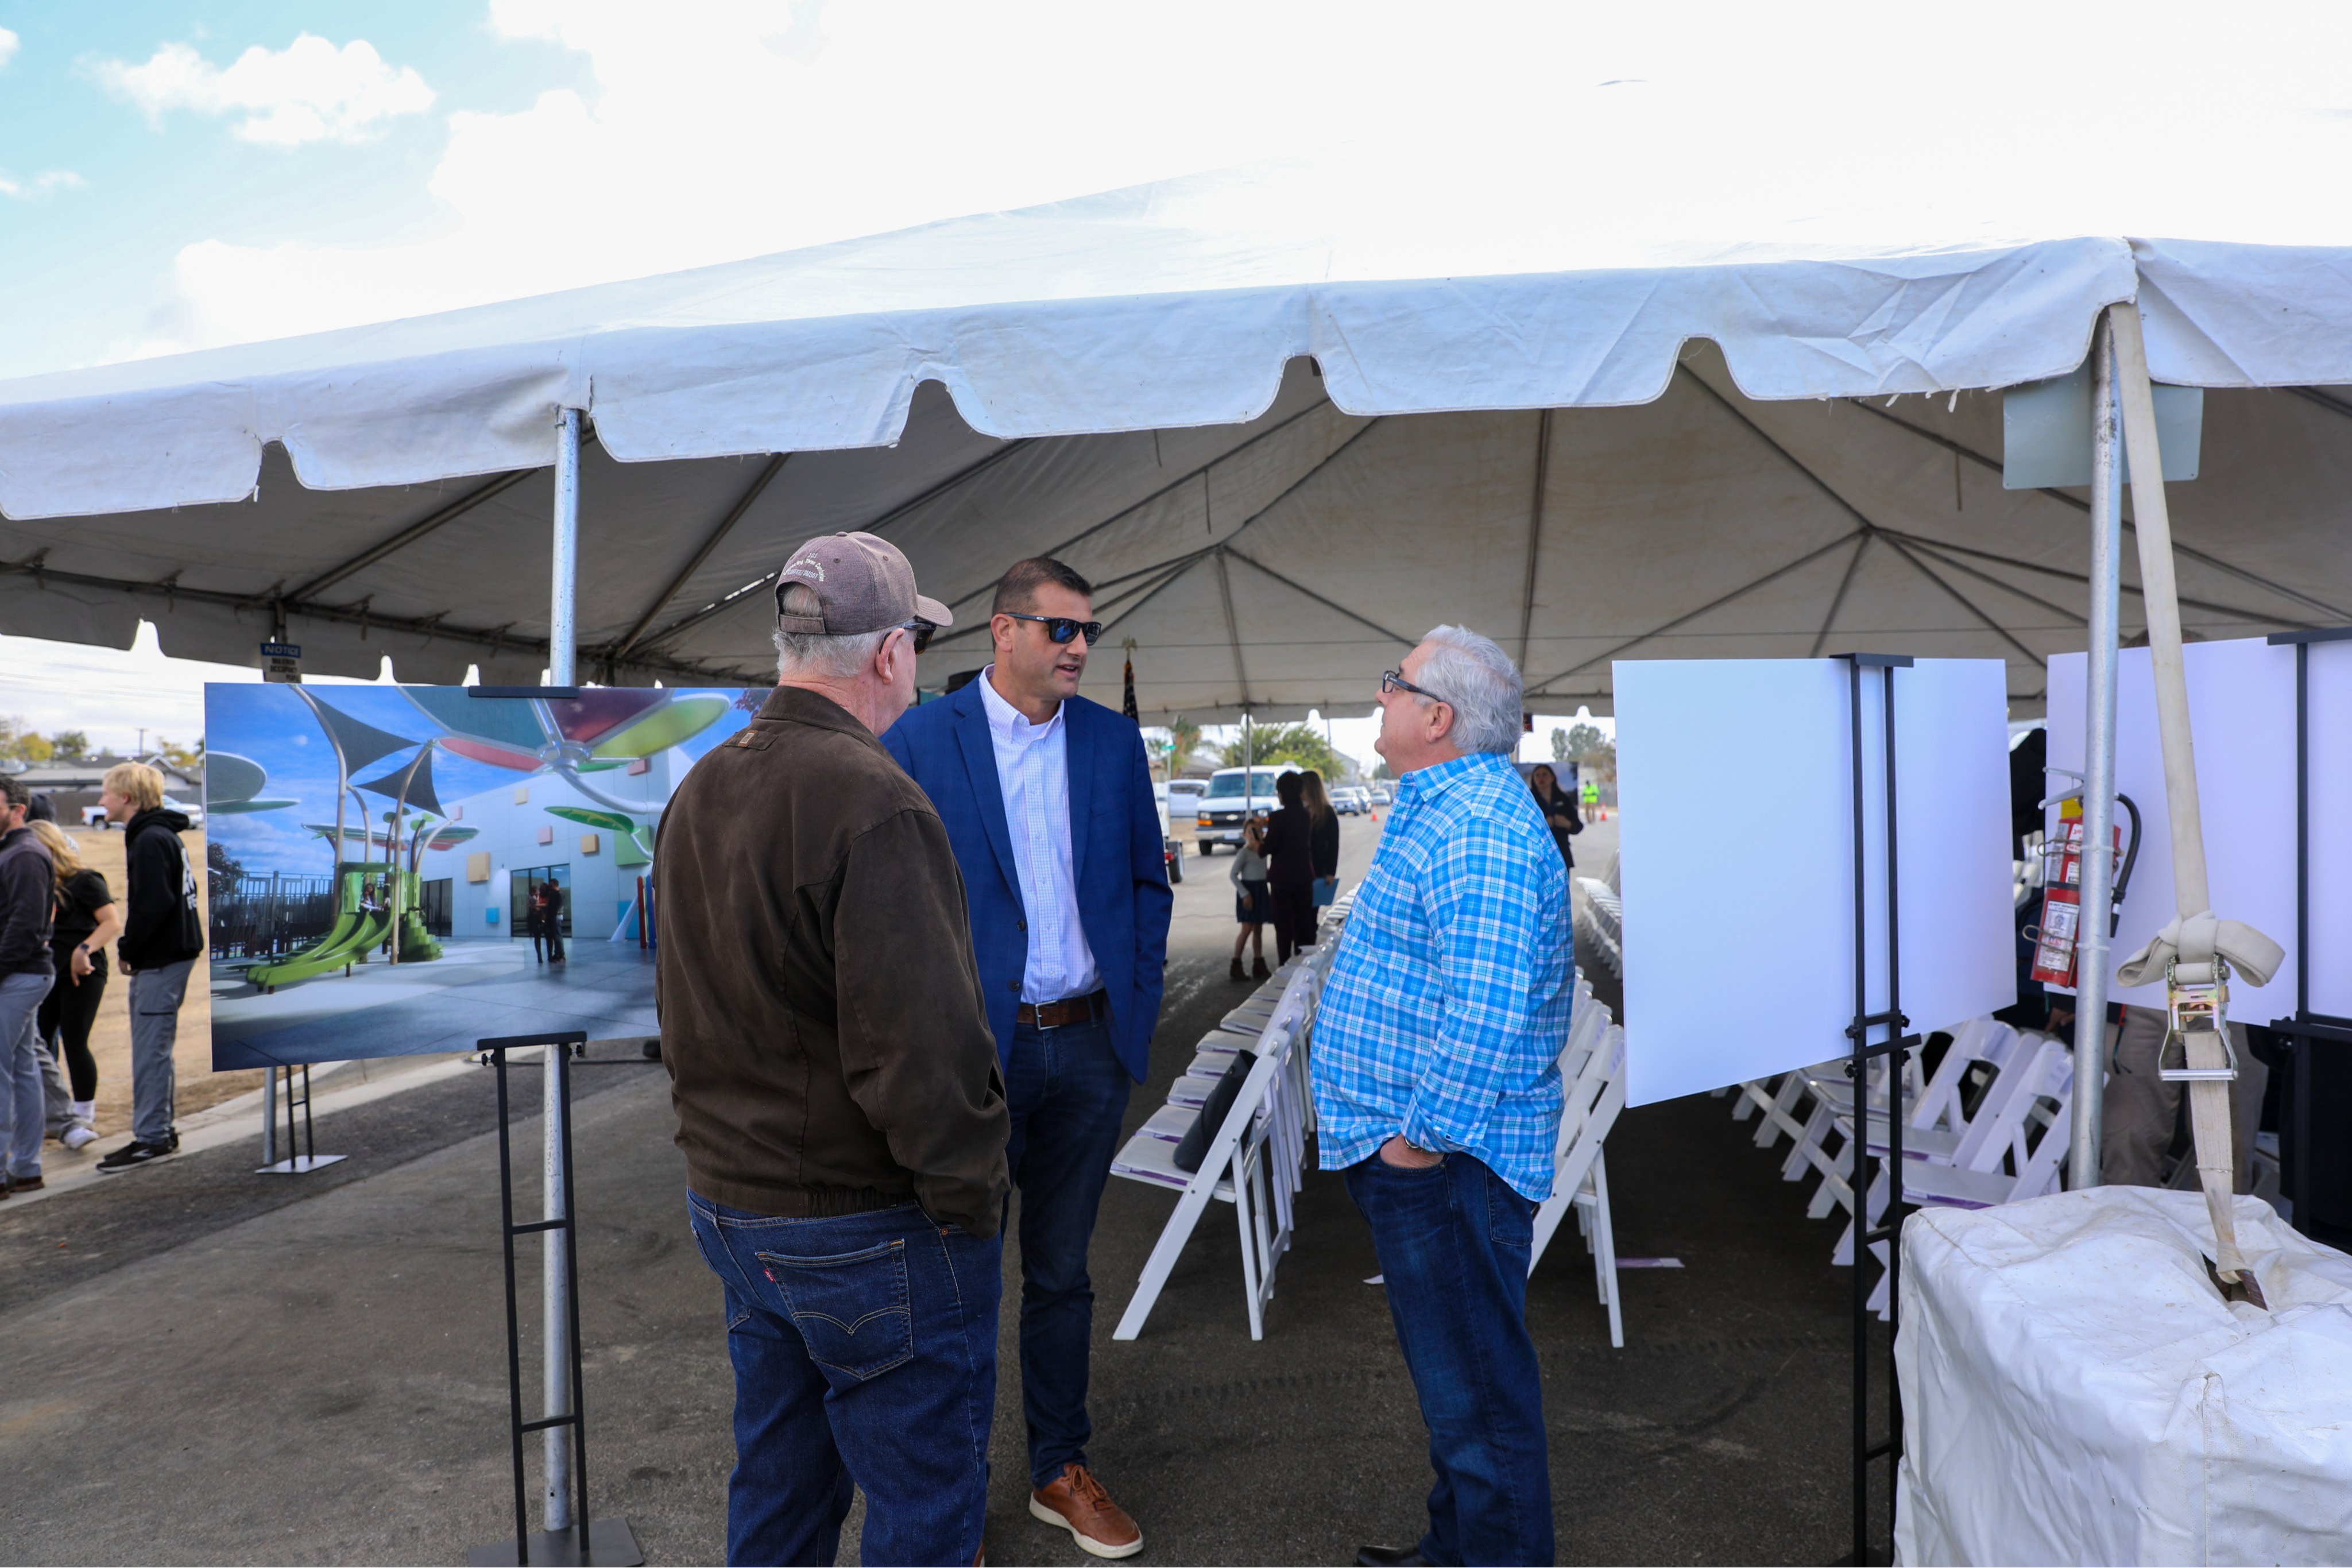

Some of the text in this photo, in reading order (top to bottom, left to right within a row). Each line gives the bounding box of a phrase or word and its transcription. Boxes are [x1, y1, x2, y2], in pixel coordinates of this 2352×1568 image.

[783, 560, 803, 575] Connecting
[815, 563, 826, 582] Centuries
[265, 645, 299, 656] NOTICE
